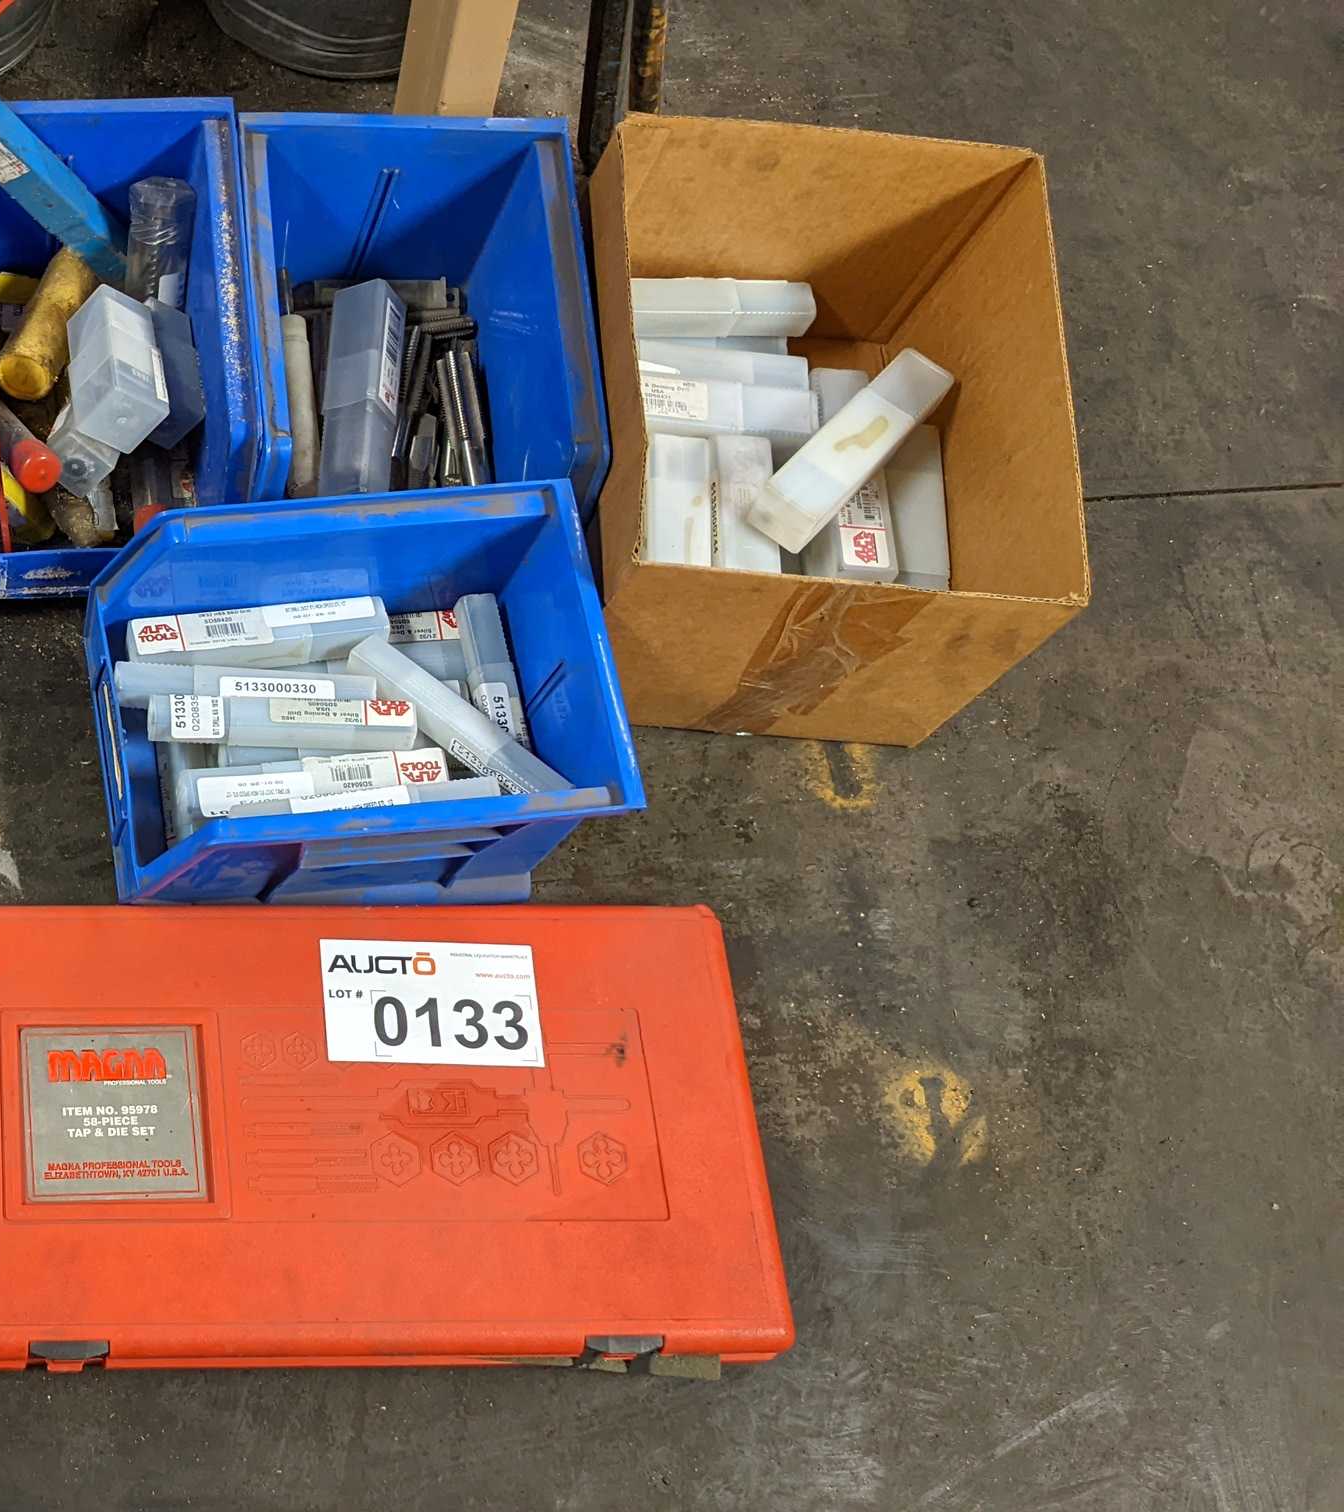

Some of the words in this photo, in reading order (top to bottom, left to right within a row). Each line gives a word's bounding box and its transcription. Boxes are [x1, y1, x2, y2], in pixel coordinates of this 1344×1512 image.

[138, 623, 177, 636] ALFA
[137, 632, 179, 643] TOOLS
[234, 681, 317, 694] 5133000330
[399, 760, 442, 772] TOOLS
[402, 770, 442, 784] ALFA
[328, 989, 353, 999] LOT
[355, 989, 364, 999] #
[373, 996, 529, 1050] 0133
[47, 1048, 167, 1083] MAGNA
[62, 1106, 93, 1117] ITEM
[96, 1105, 118, 1116] NO.
[121, 1105, 158, 1115] 95978
[83, 1116, 138, 1127] 58-PIECE
[67, 1128, 91, 1138] TAP
[95, 1127, 104, 1137] &
[107, 1127, 129, 1137] DIE
[133, 1126, 156, 1136] SET
[47, 1162, 81, 1171] MAGNA
[82, 1160, 150, 1171] PROFESSIONAL
[152, 1159, 181, 1168] TOOLS
[44, 1170, 122, 1180] ELIZABETHTOWN,
[123, 1169, 136, 1178] KY
[136, 1168, 161, 1177] 42701
